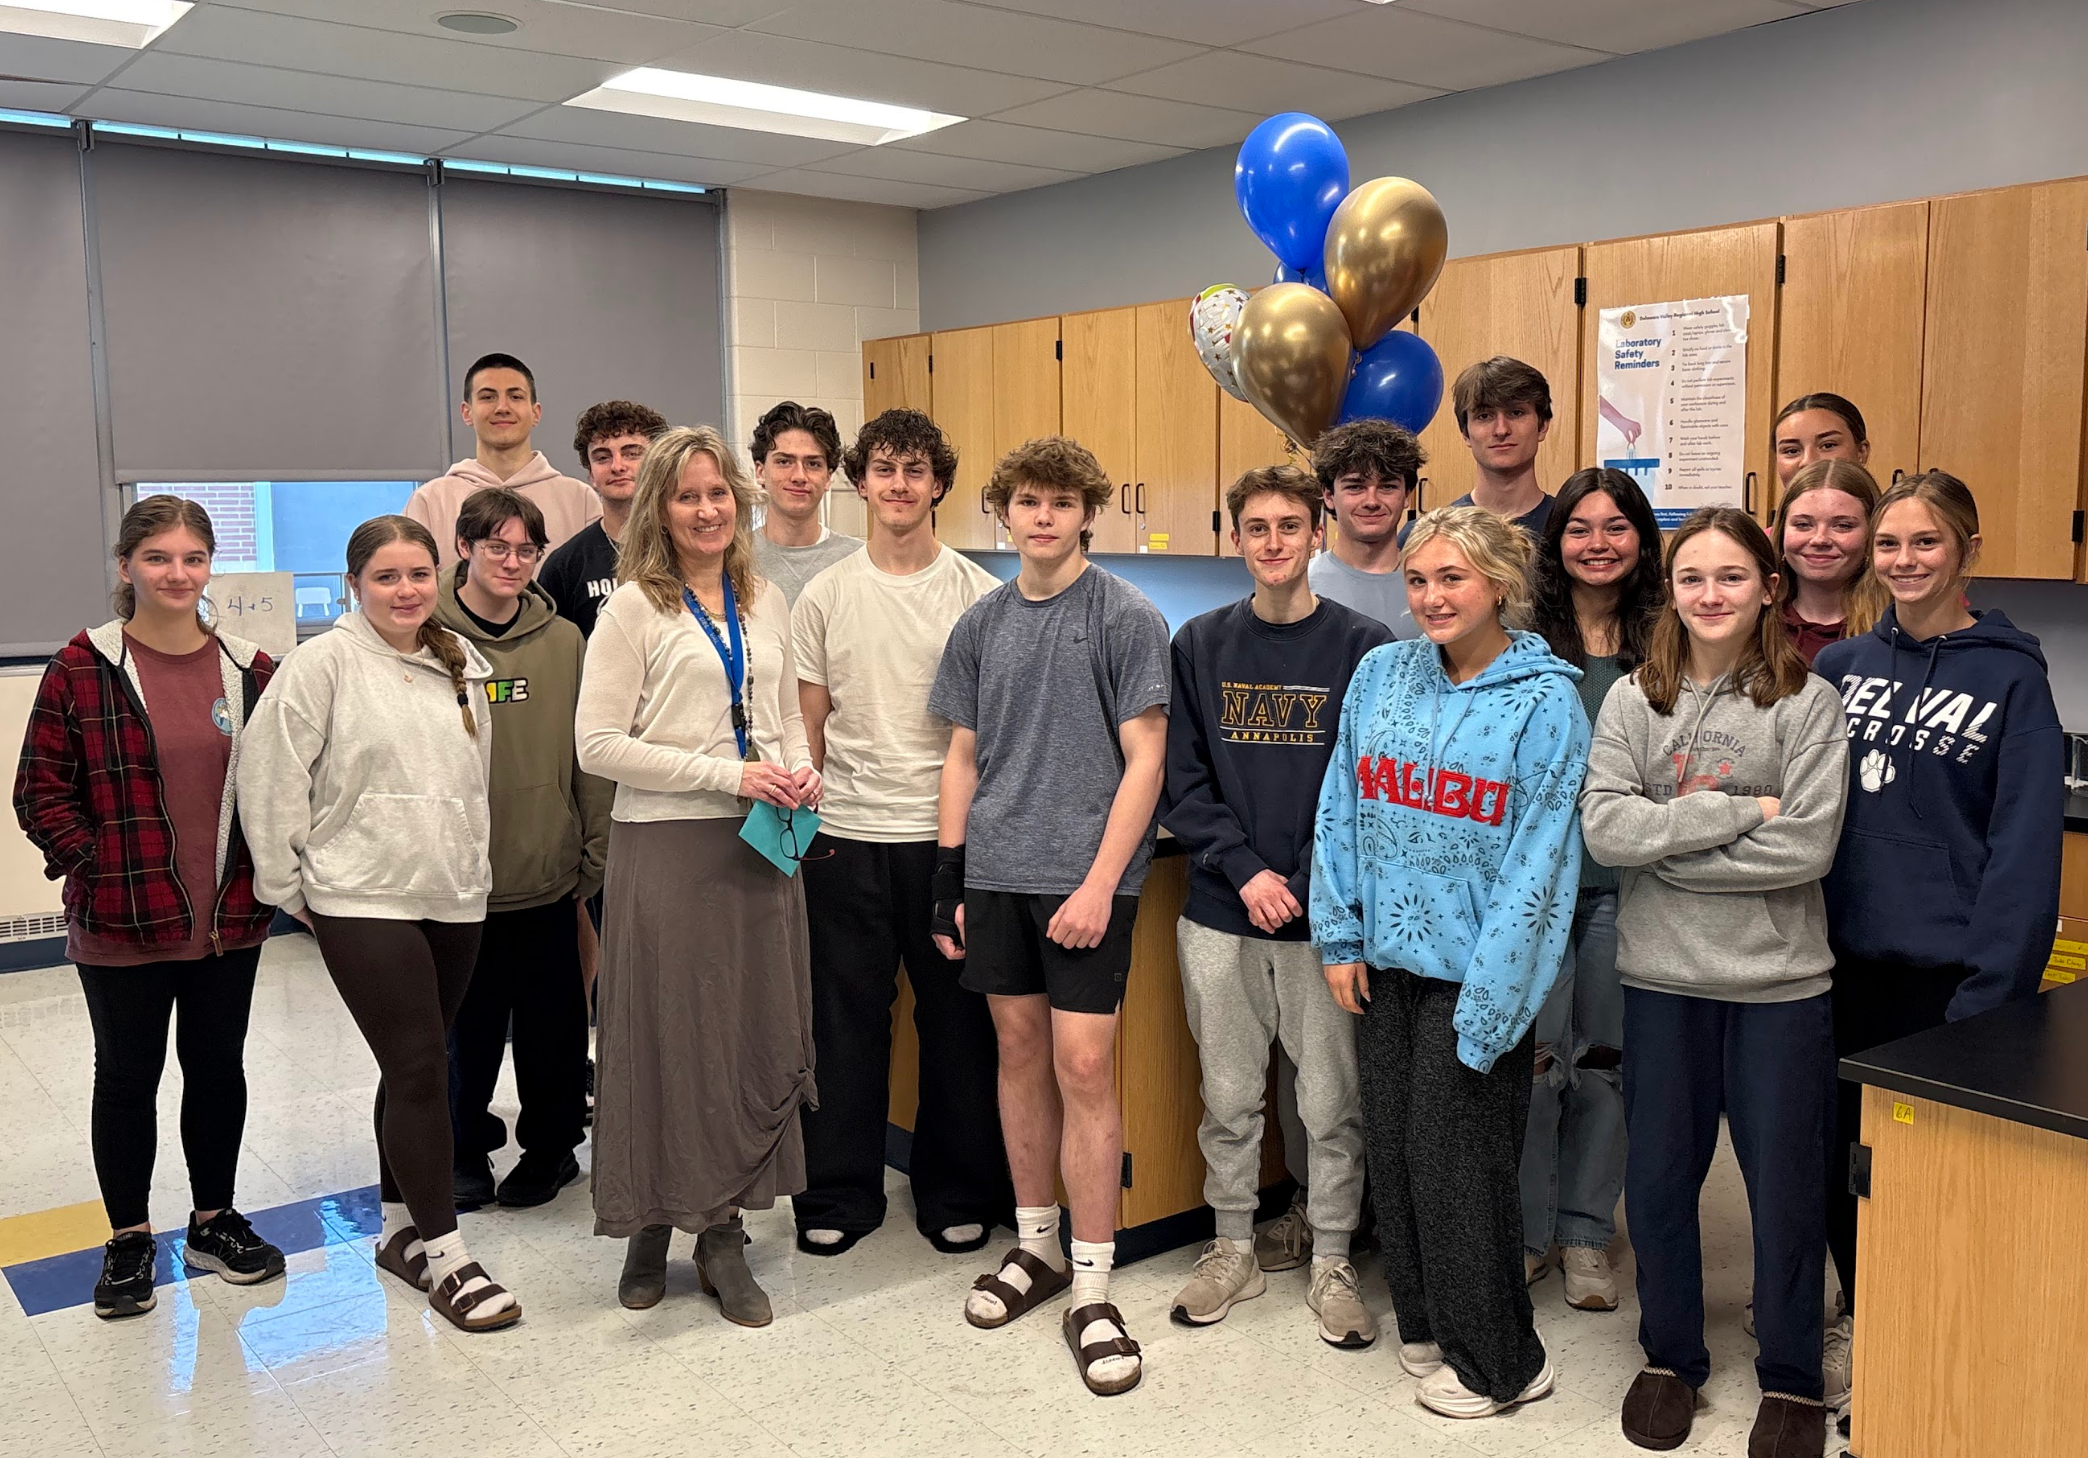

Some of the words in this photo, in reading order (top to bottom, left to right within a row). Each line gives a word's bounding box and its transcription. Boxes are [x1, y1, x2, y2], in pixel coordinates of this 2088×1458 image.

[1616, 338, 1662, 348] Laboratory
[1615, 349, 1644, 359] Safety
[1615, 359, 1660, 370] Reminders
[228, 596, 242, 616] 4
[261, 596, 273, 612] 5
[1221, 691, 1327, 727] NAVY
[1840, 674, 1903, 719] DEL
[1905, 687, 1997, 743] VAL
[1231, 731, 1313, 742] ANNAPOLIS
[1896, 1106, 1911, 1121] 6A
